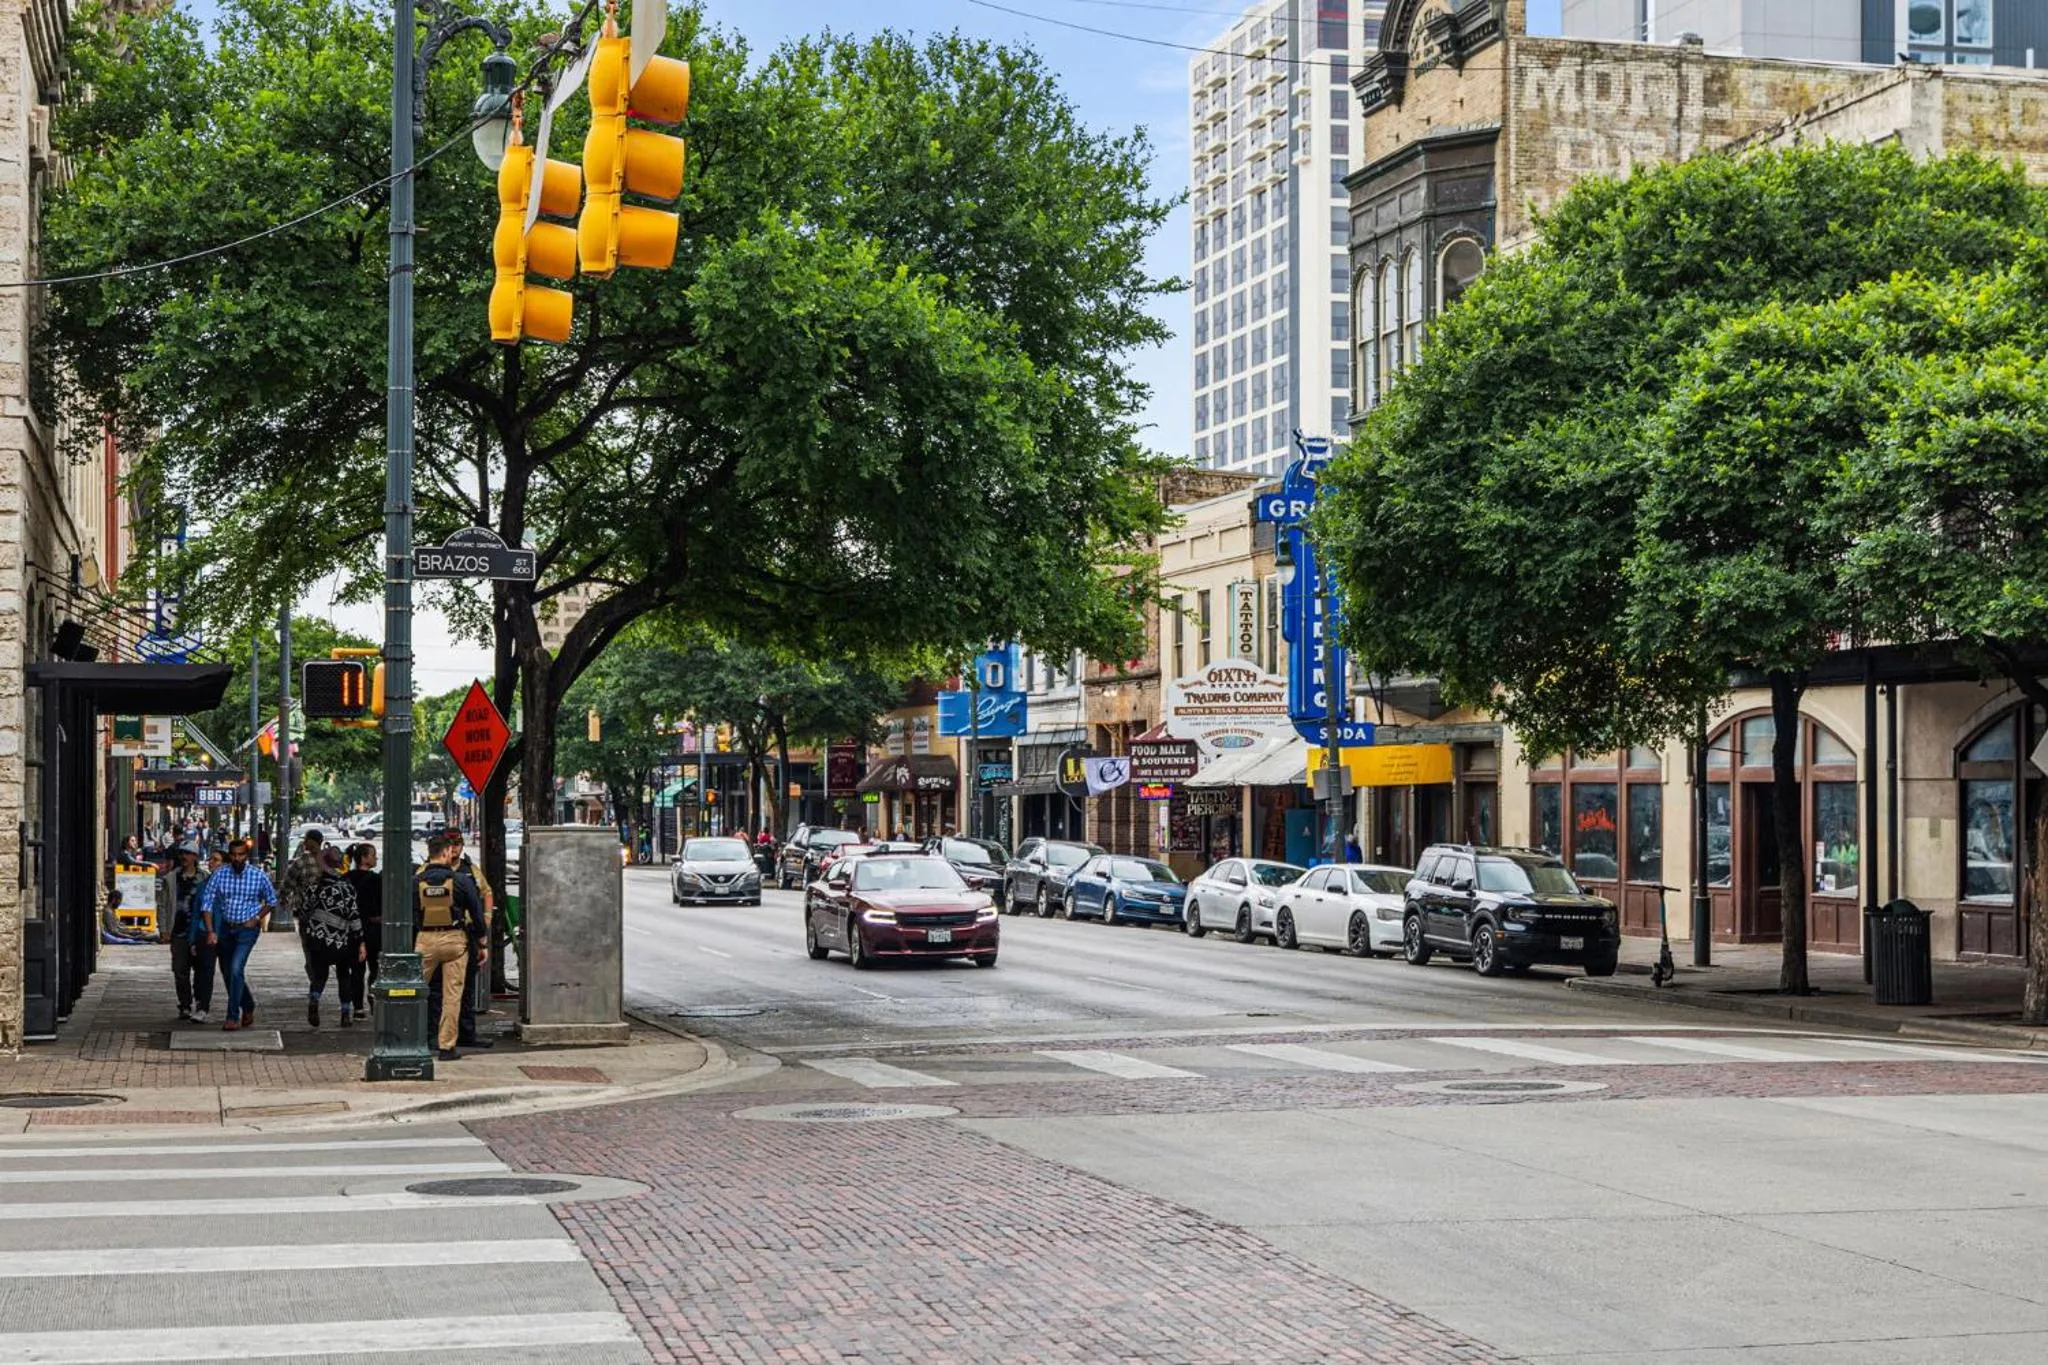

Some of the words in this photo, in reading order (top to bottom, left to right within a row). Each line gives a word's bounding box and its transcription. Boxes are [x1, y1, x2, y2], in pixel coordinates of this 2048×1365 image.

[418, 555, 490, 573] BRAZOS
[515, 558, 528, 566] ST
[1239, 591, 1253, 654] TATTOO
[342, 671, 364, 706] 11
[1184, 692, 1231, 704] TRADING
[1233, 691, 1284, 703] COMPANY
[466, 708, 489, 722] ROAD
[465, 728, 491, 743] WORK
[464, 747, 492, 764] AHEAD
[1131, 746, 1157, 755] FOOD
[1159, 745, 1186, 754] MART
[1141, 757, 1195, 765] SOUVENIRS
